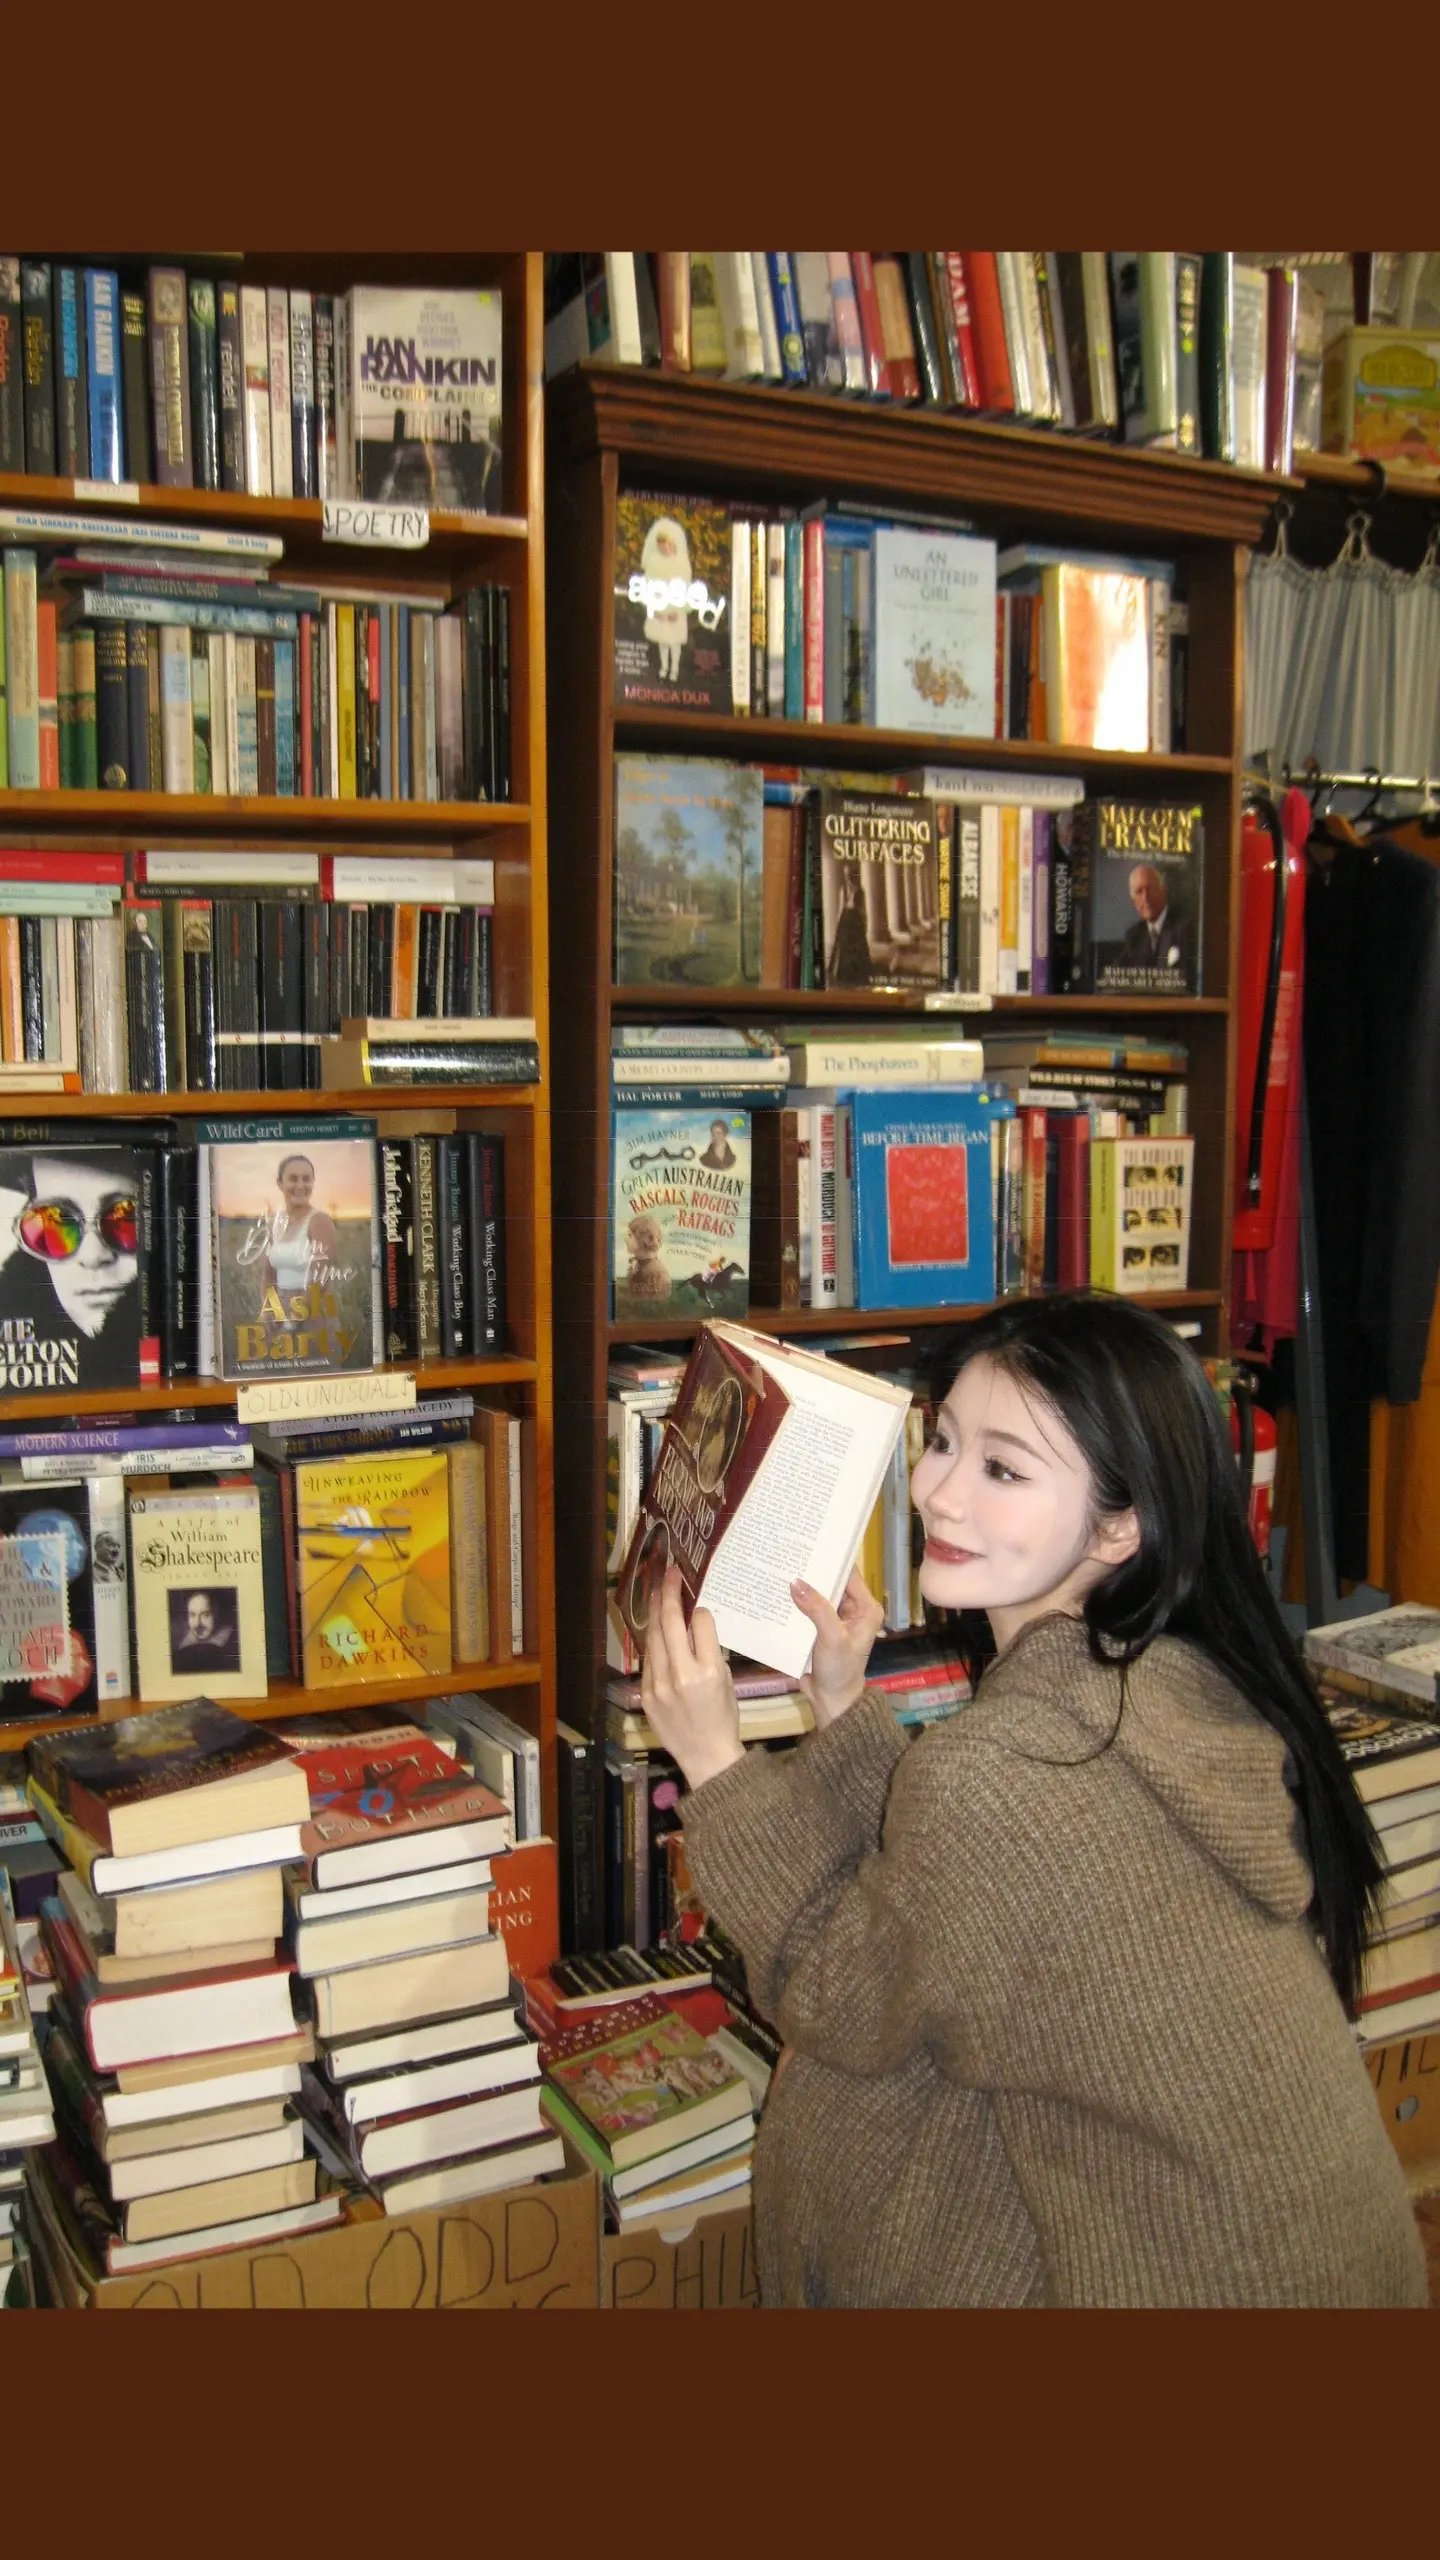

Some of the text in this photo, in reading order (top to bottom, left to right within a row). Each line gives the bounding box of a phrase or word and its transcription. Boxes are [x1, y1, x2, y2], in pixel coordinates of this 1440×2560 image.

[92, 275, 112, 306] IAN
[94, 309, 114, 376] RANKIN
[366, 335, 415, 360] IAN
[361, 353, 496, 386] RANKIN
[361, 383, 378, 393] THE
[335, 508, 424, 540] POETRY
[925, 550, 948, 566] AN
[894, 563, 979, 587] UNLETTERED
[613, 573, 727, 633] lapsed
[919, 584, 951, 601] GIRL
[624, 684, 711, 706] MONICA DUX
[825, 814, 931, 844] GLITTERING
[1100, 804, 1193, 829] MALCOLM
[833, 838, 925, 865] SURFACES
[1100, 822, 1193, 854] FRASER
[1055, 863, 1069, 935] HOWARD
[822, 1055, 846, 1071] The
[616, 1091, 639, 1102] HAL
[641, 1090, 683, 1101] PORTER
[700, 1090, 720, 1099] MARY
[13, 1123, 49, 1140] Bell
[206, 1123, 243, 1139] Wild
[244, 1121, 285, 1138] Card
[626, 1130, 690, 1151] JIM HAYNES
[862, 1129, 990, 1146] BEFORE TIME BEGAN
[385, 1146, 404, 1189] John
[447, 1151, 461, 1185] Jimmy
[621, 1167, 745, 1197] GREAT AUSTRALIAN
[821, 1114, 837, 1275] MAN BITES MURDOCH GUTHRIE
[420, 1145, 435, 1274] KENNETH CLARK
[629, 1187, 740, 1218] RASCALS, ROGUES
[257, 1201, 290, 1237] My
[678, 1207, 736, 1240] RATBAGS
[450, 1223, 463, 1272] Working
[484, 1221, 496, 1268] Working
[303, 1254, 358, 1291] Time
[452, 1272, 463, 1299] Class
[485, 1268, 496, 1295] Class
[255, 1283, 340, 1324] Ash
[453, 1300, 464, 1322] Boy
[487, 1297, 496, 1321] Man
[235, 1323, 359, 1364] Barty
[248, 1378, 397, 1415] OLD UNUSUAL
[397, 1401, 455, 1417] TRAGEDY
[15, 1431, 119, 1451] MODERN SCIENCE
[400, 1427, 411, 1437] IAN
[411, 1425, 433, 1437] WILSON
[121, 1462, 171, 1475] MURDOCH
[136, 1453, 156, 1463] IRIS
[303, 1472, 403, 1492] UNWEAVING
[332, 1486, 433, 1506] THE RAINBOW
[157, 1517, 241, 1529] A Life of
[511, 1512, 521, 1528] Rugs
[171, 1529, 229, 1543] William
[511, 1529, 520, 1543] and
[138, 1540, 260, 1573] Shakespeare
[512, 1545, 522, 1571] Carpets
[512, 1582, 522, 1609] Europe
[319, 1623, 430, 1649] RICHARD
[320, 1645, 429, 1670] DAWKINS
[316, 1752, 446, 1785] SPOT of
[314, 1798, 486, 1842] BOTHER
[365, 2196, 560, 2308] ODD
